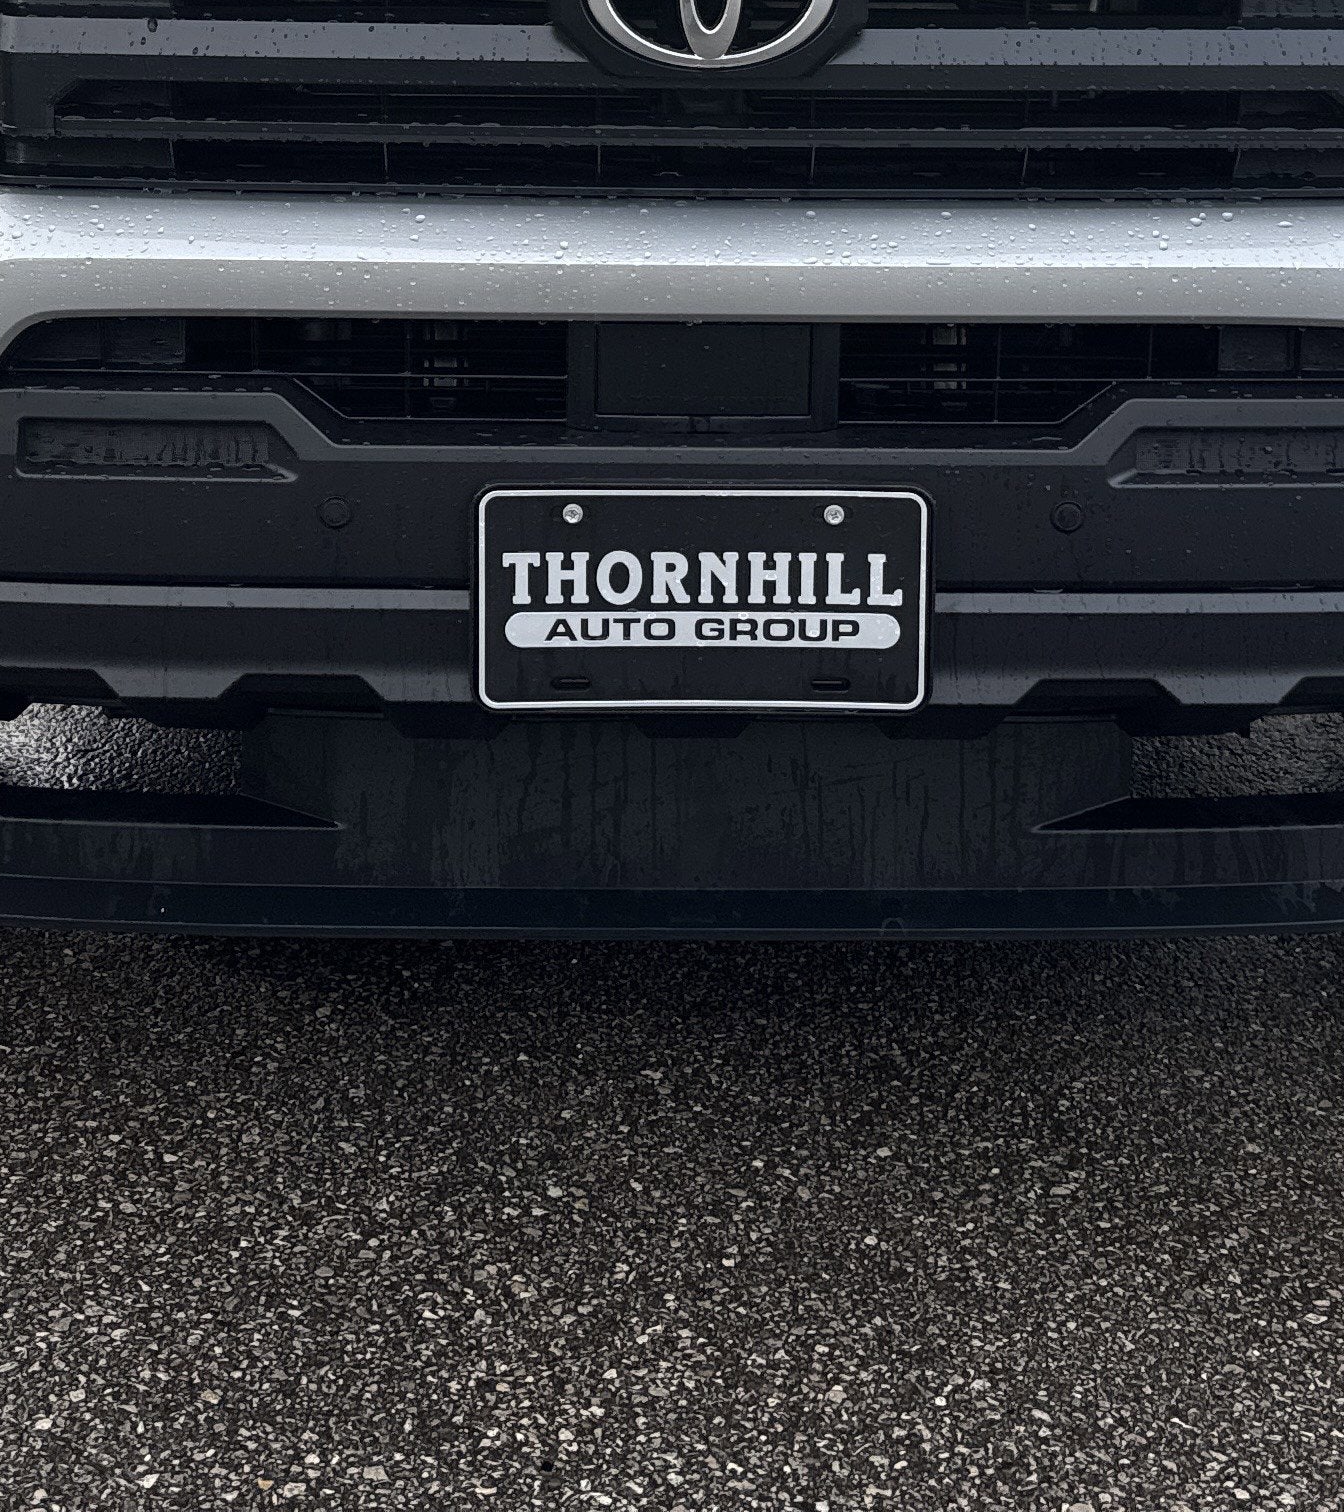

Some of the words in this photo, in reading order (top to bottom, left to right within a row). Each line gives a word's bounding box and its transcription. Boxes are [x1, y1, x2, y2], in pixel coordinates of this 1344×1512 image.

[502, 550, 904, 606] THORNHILL
[544, 618, 677, 642] AUTO
[693, 618, 861, 642] GROUP
